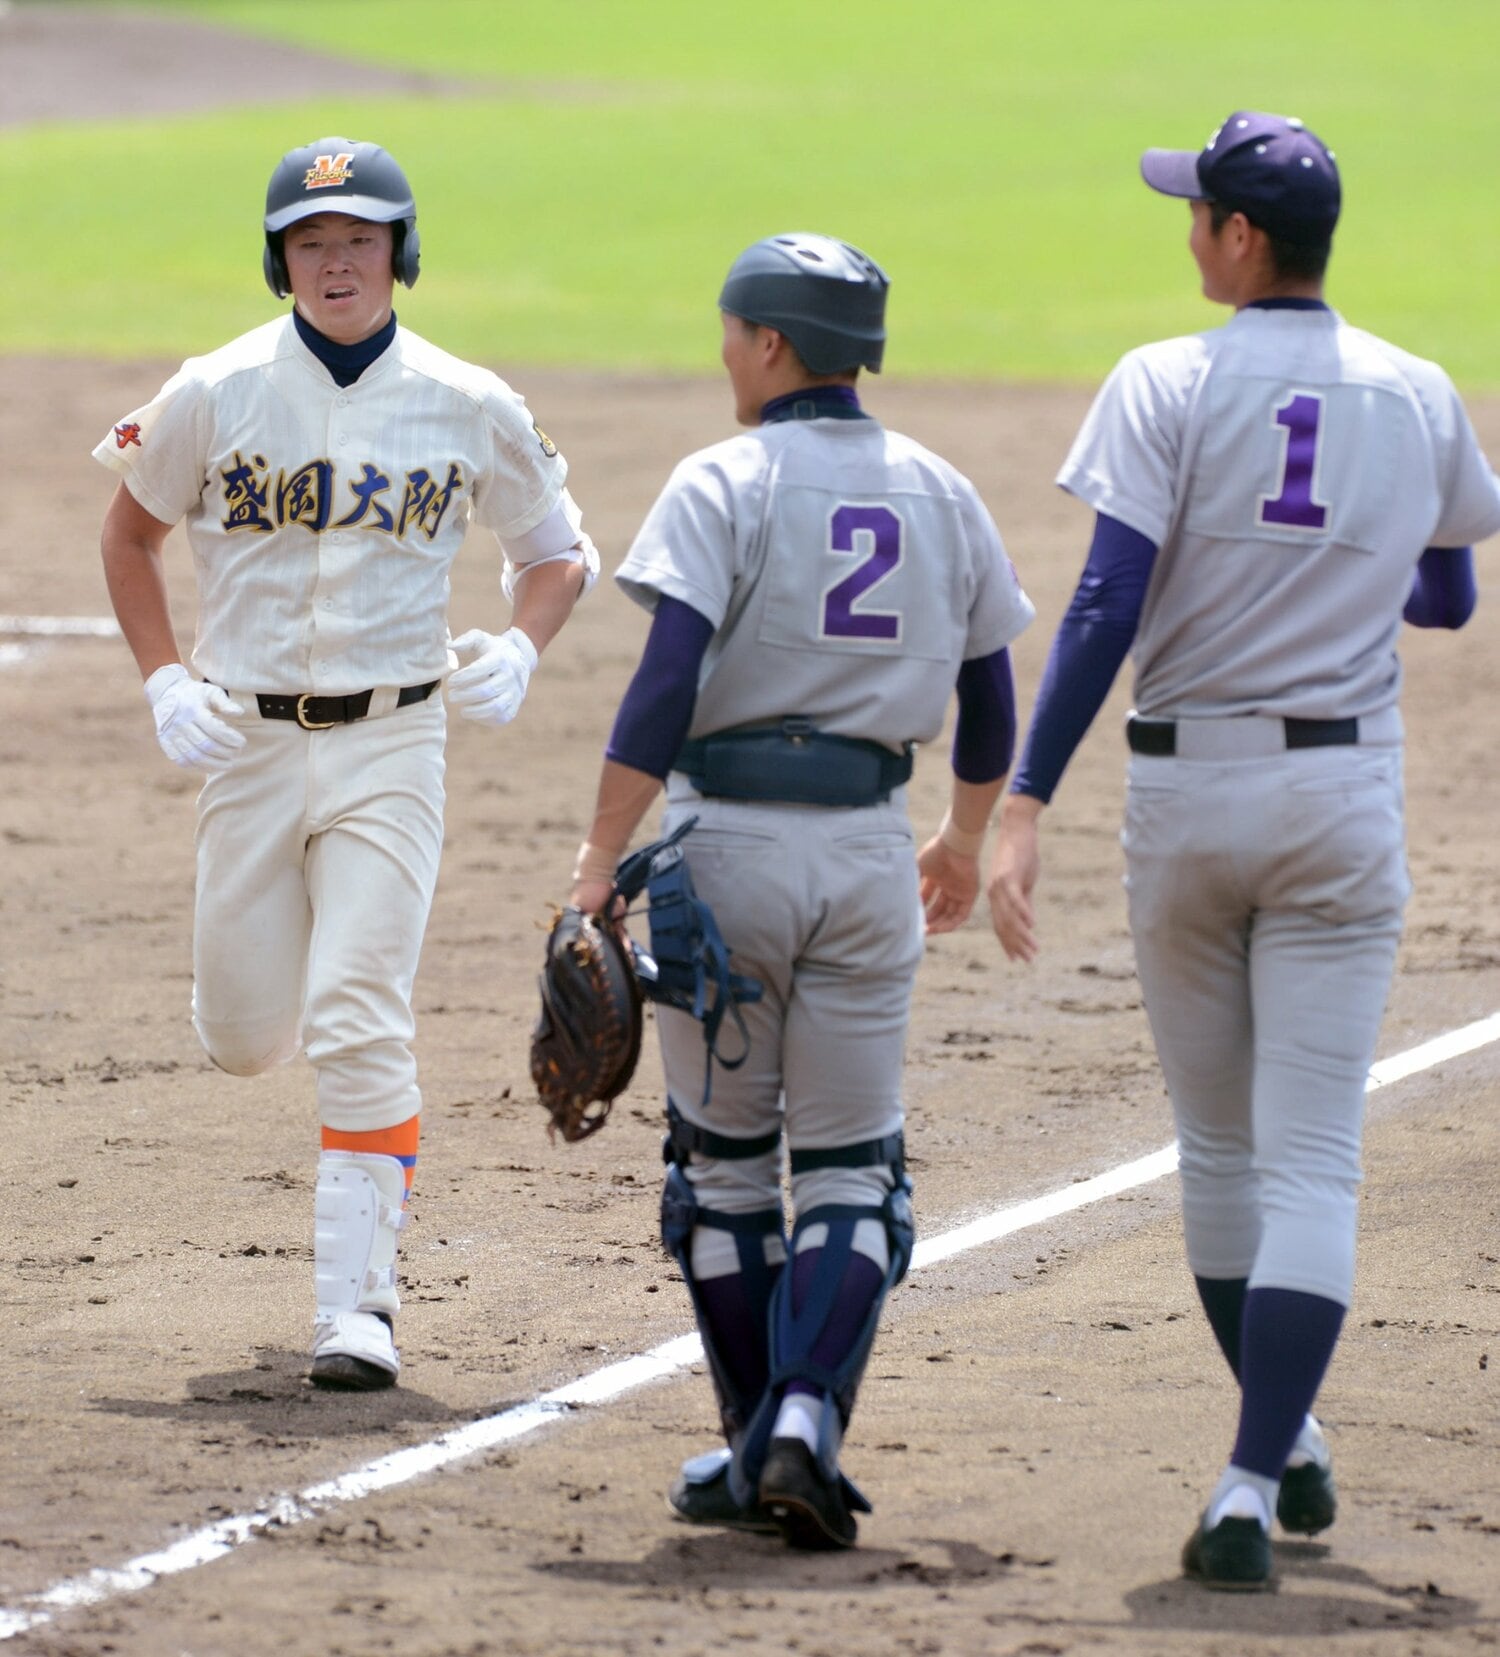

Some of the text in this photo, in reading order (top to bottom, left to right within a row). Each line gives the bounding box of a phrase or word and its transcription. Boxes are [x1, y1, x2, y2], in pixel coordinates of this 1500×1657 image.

[221, 451, 463, 542] 盛岡大附
[1255, 388, 1332, 533] 1
[818, 500, 905, 643] 2
